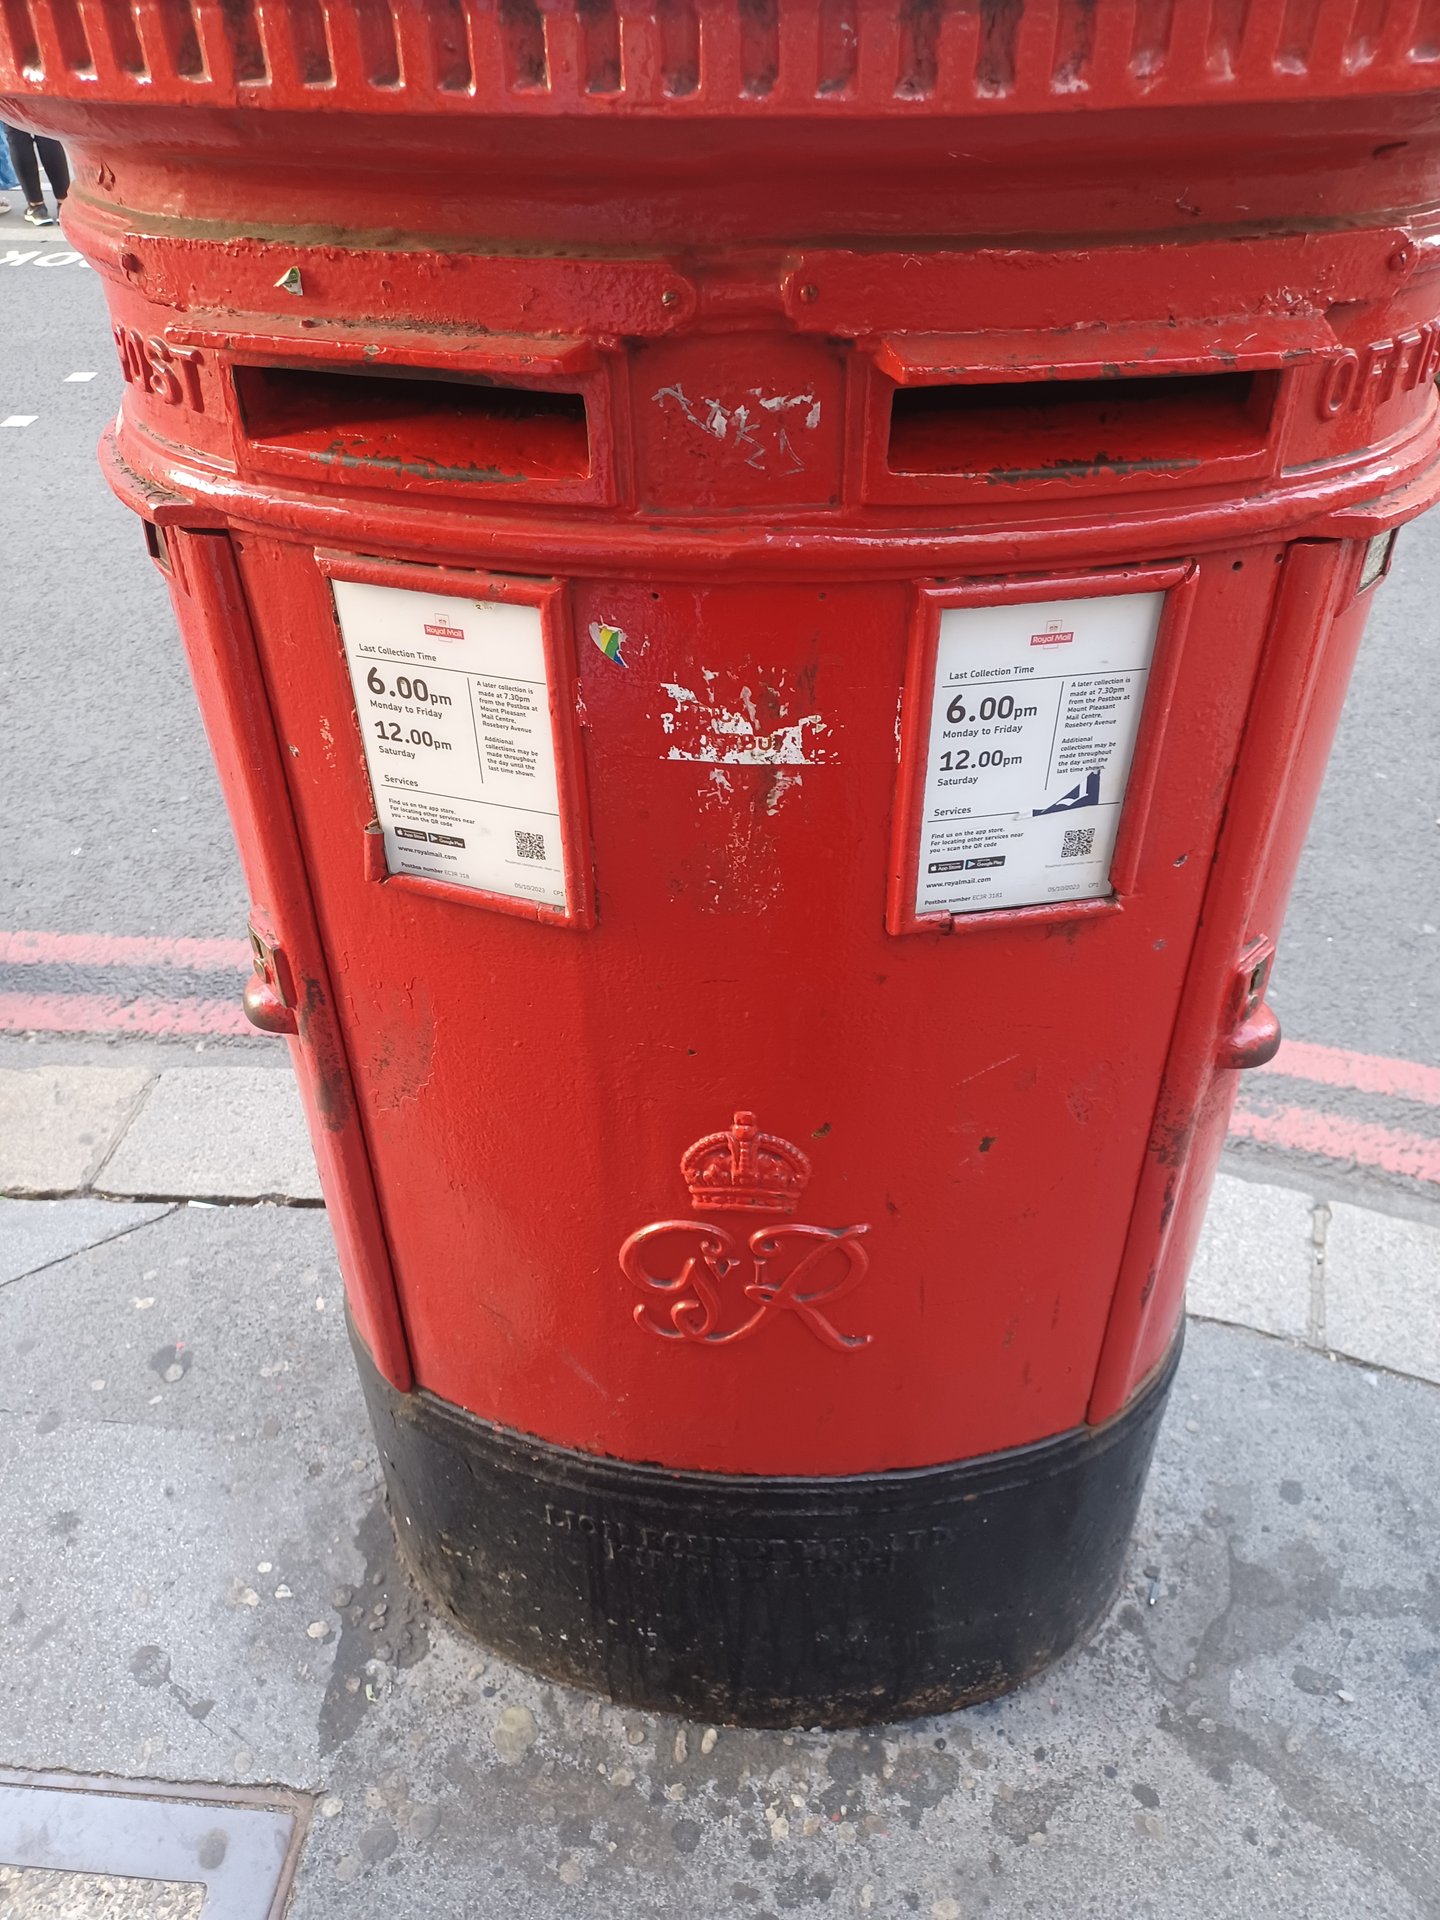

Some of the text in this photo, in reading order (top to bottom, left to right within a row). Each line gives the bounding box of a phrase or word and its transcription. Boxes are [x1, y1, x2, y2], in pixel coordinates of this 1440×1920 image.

[113, 324, 204, 413] POST
[426, 626, 463, 638] Royal Mail
[1033, 634, 1072, 644] Royal Mail
[359, 643, 437, 661] Last Collection Time
[949, 672, 968, 680] Last
[970, 668, 1011, 678] Collection
[368, 667, 452, 706] 6.00pm
[498, 684, 527, 694] collection
[1078, 680, 1092, 688] later
[1094, 678, 1124, 687] collection
[478, 690, 495, 698] made
[504, 693, 530, 703] 7.30pm
[1098, 687, 1125, 695] 7.30pm
[370, 700, 442, 719] Monday to Friday
[480, 706, 526, 718] Mount Pleasant
[507, 701, 530, 711] Postbox
[947, 694, 1037, 724] 6.00pm
[1066, 713, 1080, 721] Mail
[483, 721, 532, 734] Rosebery Avenue
[1065, 721, 1093, 729] Rosebery
[375, 721, 452, 750] 12.00pm
[943, 729, 979, 739] Monday
[994, 725, 1023, 734] Friday
[485, 736, 514, 745] Additional
[1062, 736, 1093, 744] Additional
[379, 746, 415, 759] Saturday
[486, 744, 516, 753] collections
[518, 749, 529, 757] may
[1061, 744, 1093, 752] collections
[1095, 742, 1107, 750] may
[487, 751, 537, 764] made throughout
[1078, 749, 1112, 759] throughout
[487, 757, 497, 765] the
[499, 760, 509, 768] day
[526, 763, 535, 771] the
[940, 750, 1022, 772] 12.00pm
[501, 767, 514, 775] time
[385, 775, 419, 787] Services
[938, 777, 978, 786] Saturday
[400, 806, 422, 816] locating
[424, 810, 437, 818] other
[439, 814, 461, 823] services
[429, 805, 439, 813] app
[934, 807, 972, 817] Services
[392, 812, 400, 820] you
[976, 829, 987, 837] app
[942, 838, 966, 847] locating
[398, 846, 457, 861] www.royalmail.com
[401, 862, 422, 871] Postbox
[423, 867, 443, 875] number
[926, 877, 991, 889] www.royalmail.com
[925, 898, 947, 906] Postbox
[949, 895, 971, 904] number
